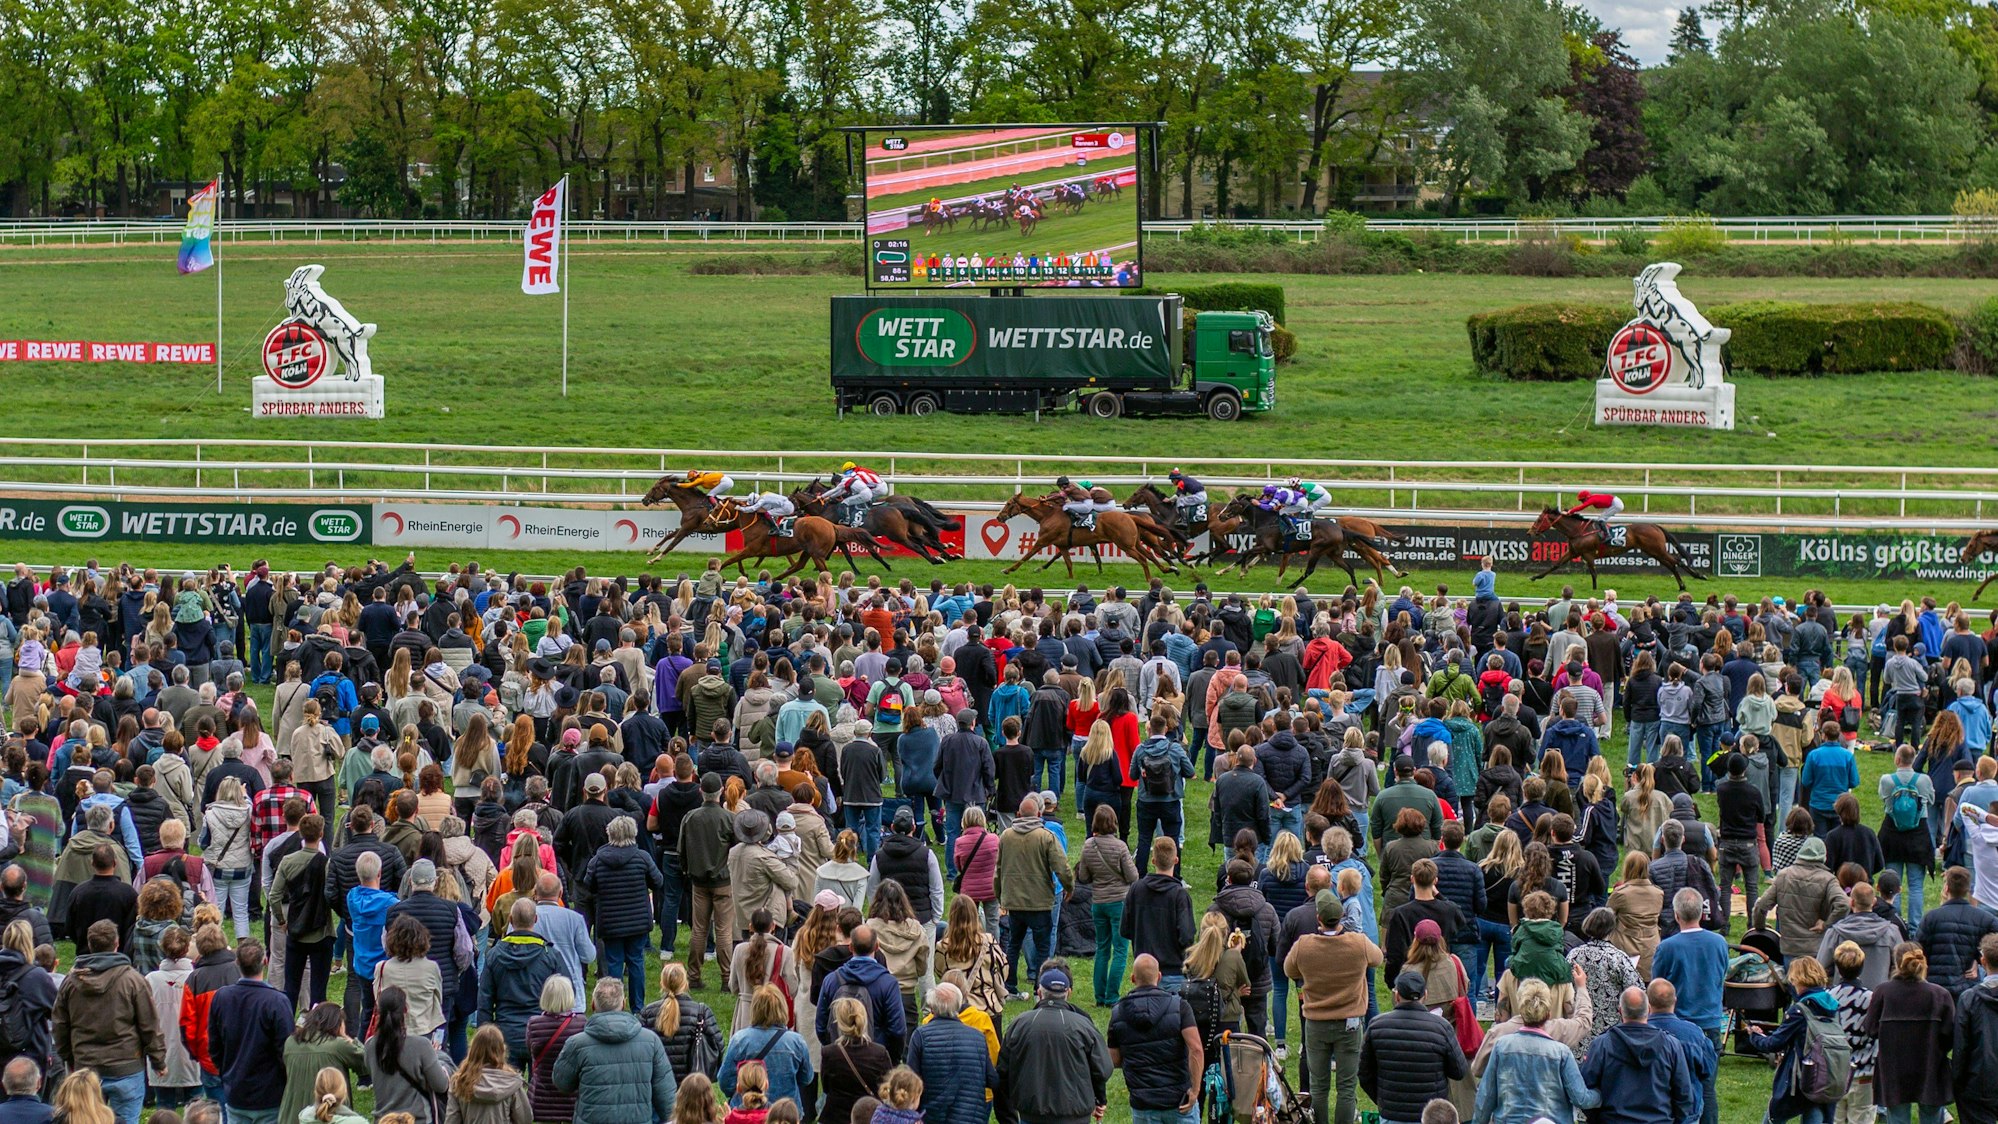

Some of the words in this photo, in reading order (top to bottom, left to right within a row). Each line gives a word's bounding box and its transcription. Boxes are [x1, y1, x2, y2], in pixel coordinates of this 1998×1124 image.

[529, 187, 557, 286] REWE
[878, 317, 945, 337] WETT
[988, 327, 1153, 349] WETTSTAR.de
[27, 343, 81, 359] REWE
[92, 344, 146, 360] REWE
[156, 345, 212, 361] REWE
[895, 338, 956, 358] STAR
[281, 362, 307, 379] KÖLN
[1624, 366, 1651, 383] KÖLN
[262, 399, 315, 415] SPÜRBAR
[319, 401, 368, 415] ANDERS.
[1603, 405, 1656, 422] SPÜRBAR
[1660, 410, 1710, 425] ANDERS.
[69, 513, 95, 522] WETT
[855, 510, 863, 521] 6
[1195, 504, 1207, 515] 8
[76, 521, 99, 530] STAR
[122, 511, 297, 536] WETTSTAR.de
[320, 517, 346, 525] WETT
[408, 520, 483, 535] RheinEnergie
[1296, 520, 1312, 534] 10
[327, 525, 351, 534] STAR
[525, 524, 600, 540] RheinEnergie
[1612, 527, 1627, 540] 12
[1462, 539, 1529, 561] LANXESS
[1800, 538, 1868, 561] Kölns
